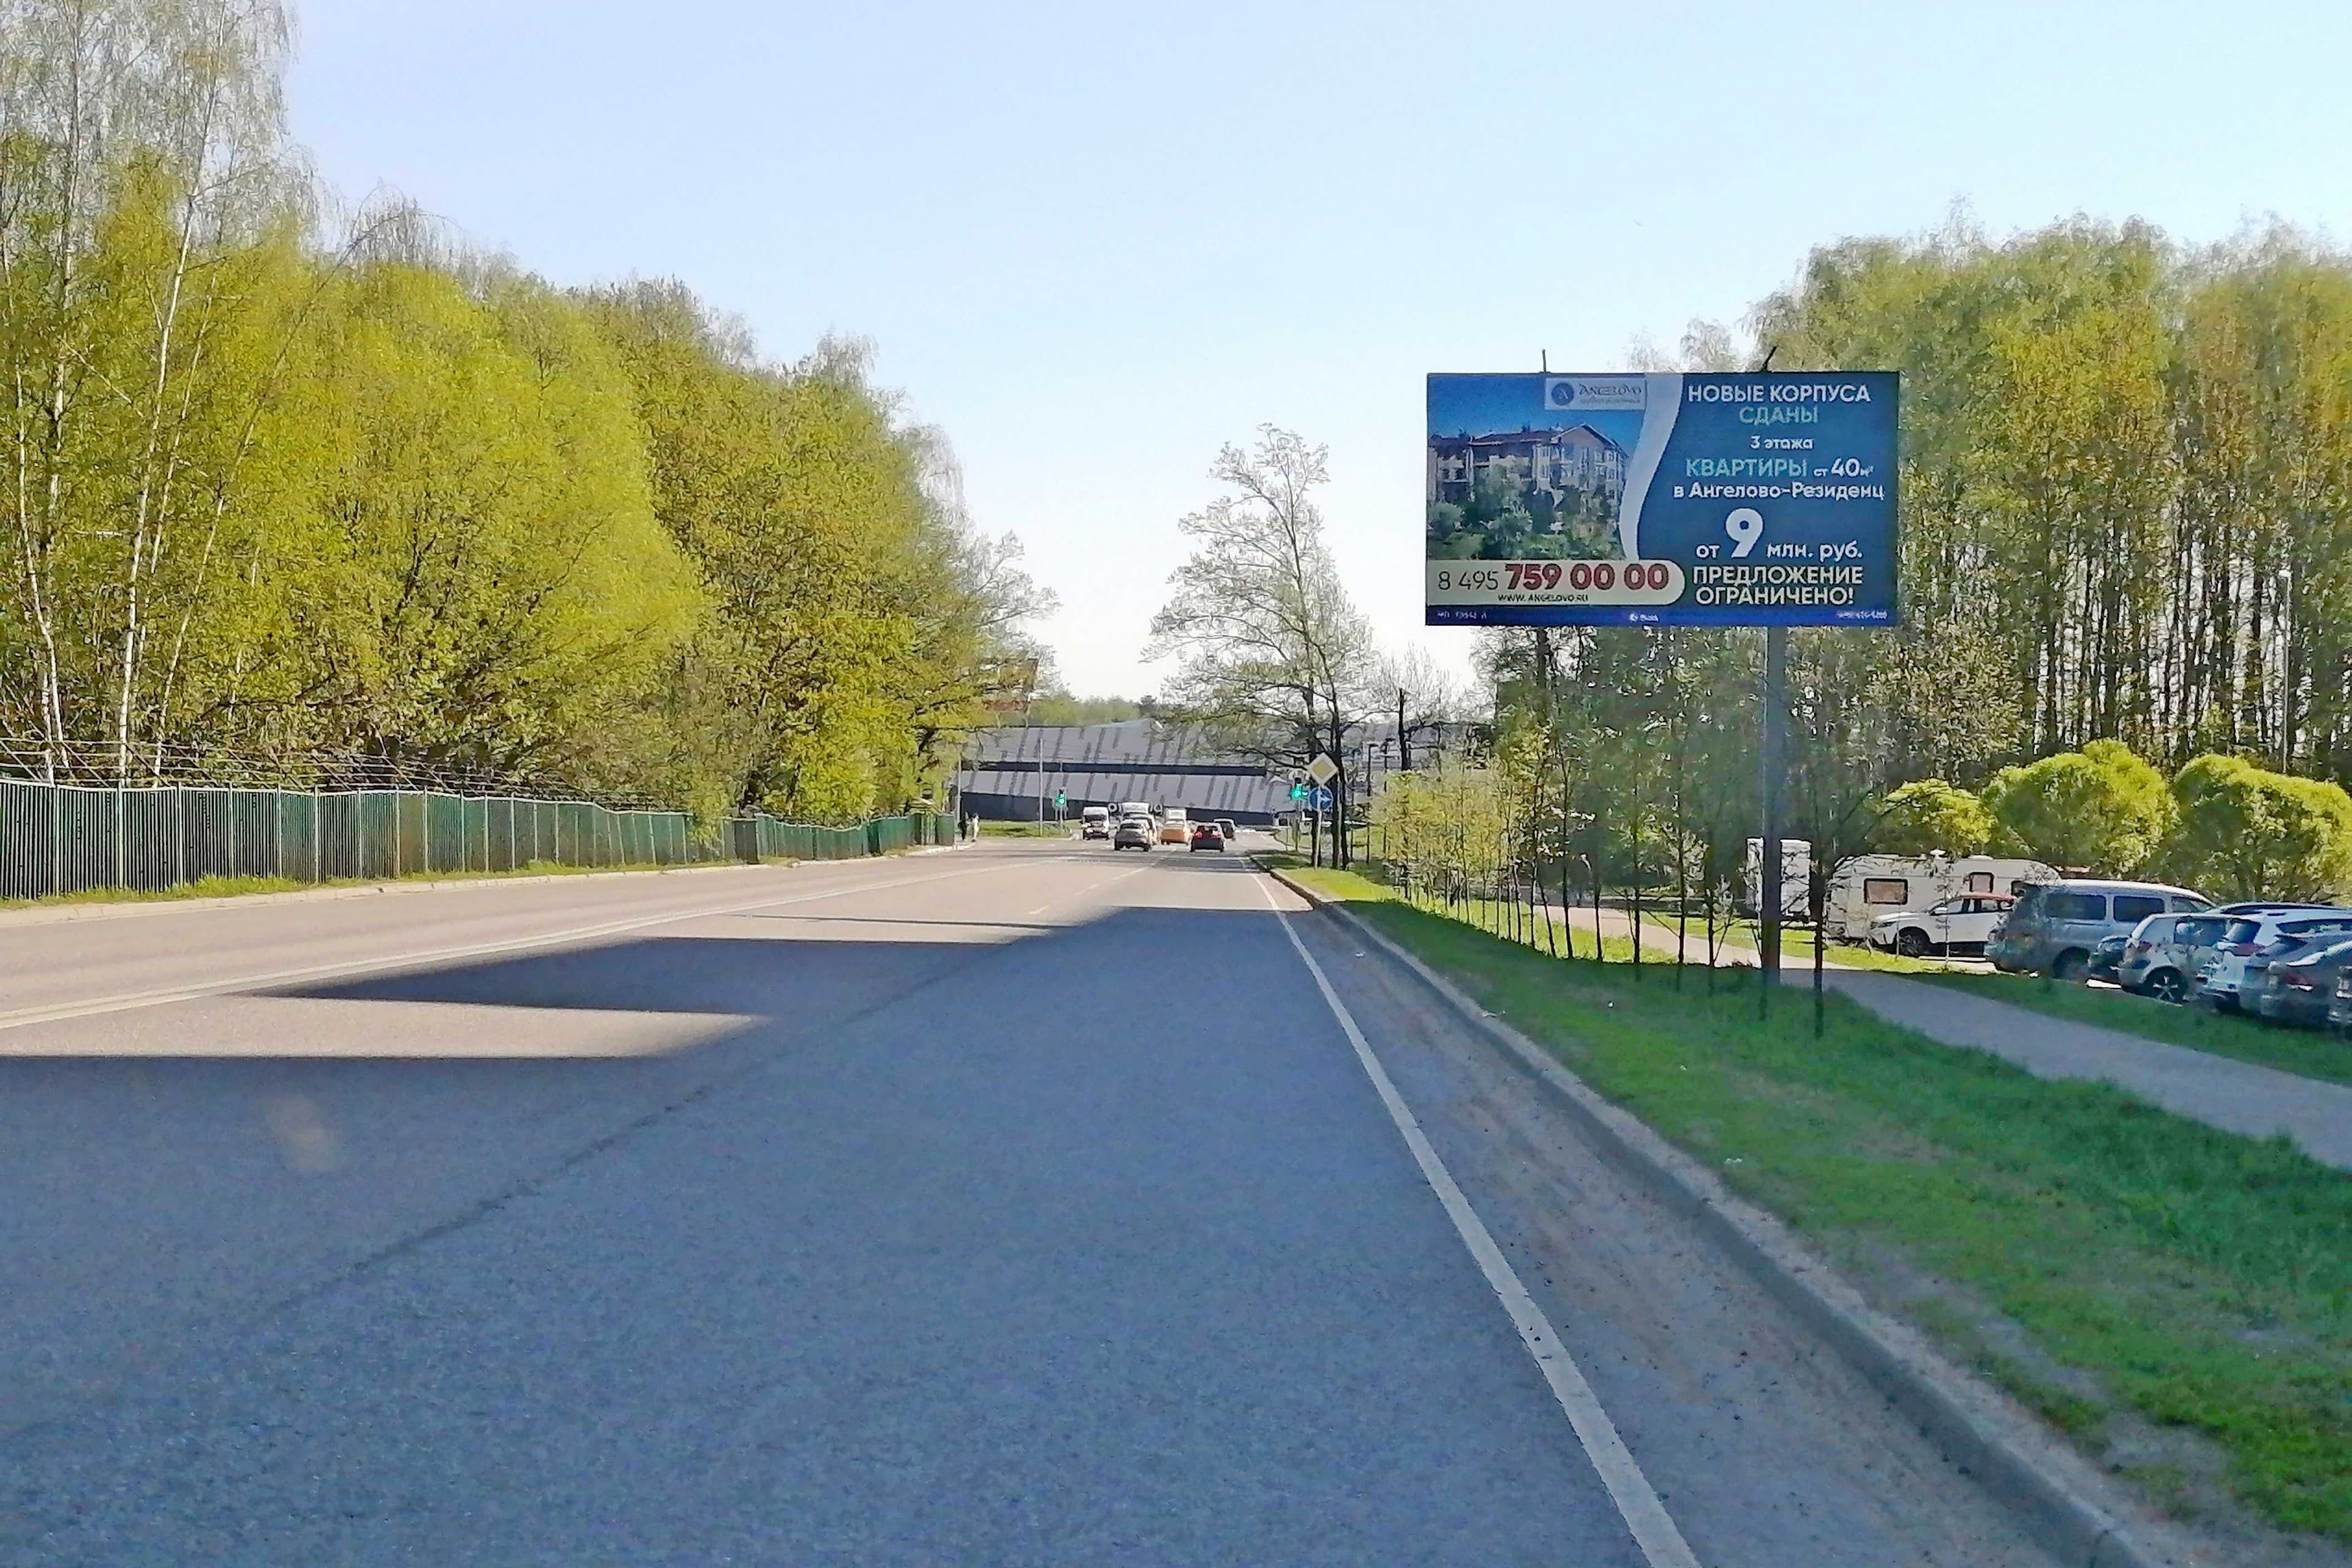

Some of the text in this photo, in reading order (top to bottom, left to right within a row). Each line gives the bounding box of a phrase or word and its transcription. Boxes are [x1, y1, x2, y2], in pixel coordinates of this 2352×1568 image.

[1688, 384, 1871, 402] НОВЫЕ КОРПУСА
[1739, 405, 1818, 426] СДАНЫ
[1750, 435, 1814, 450] 3 этажа
[1686, 459, 1807, 477] КВАРТИРЫ
[1673, 485, 1684, 498] в
[1696, 508, 1863, 563] от 9 млн. руб.
[1438, 563, 1669, 590] 8 495 759 00 00
[1693, 567, 1863, 586] ПРЕДЛОЖЕНИЕ
[1695, 587, 1854, 605] ОГРАНИЧЕНО!
